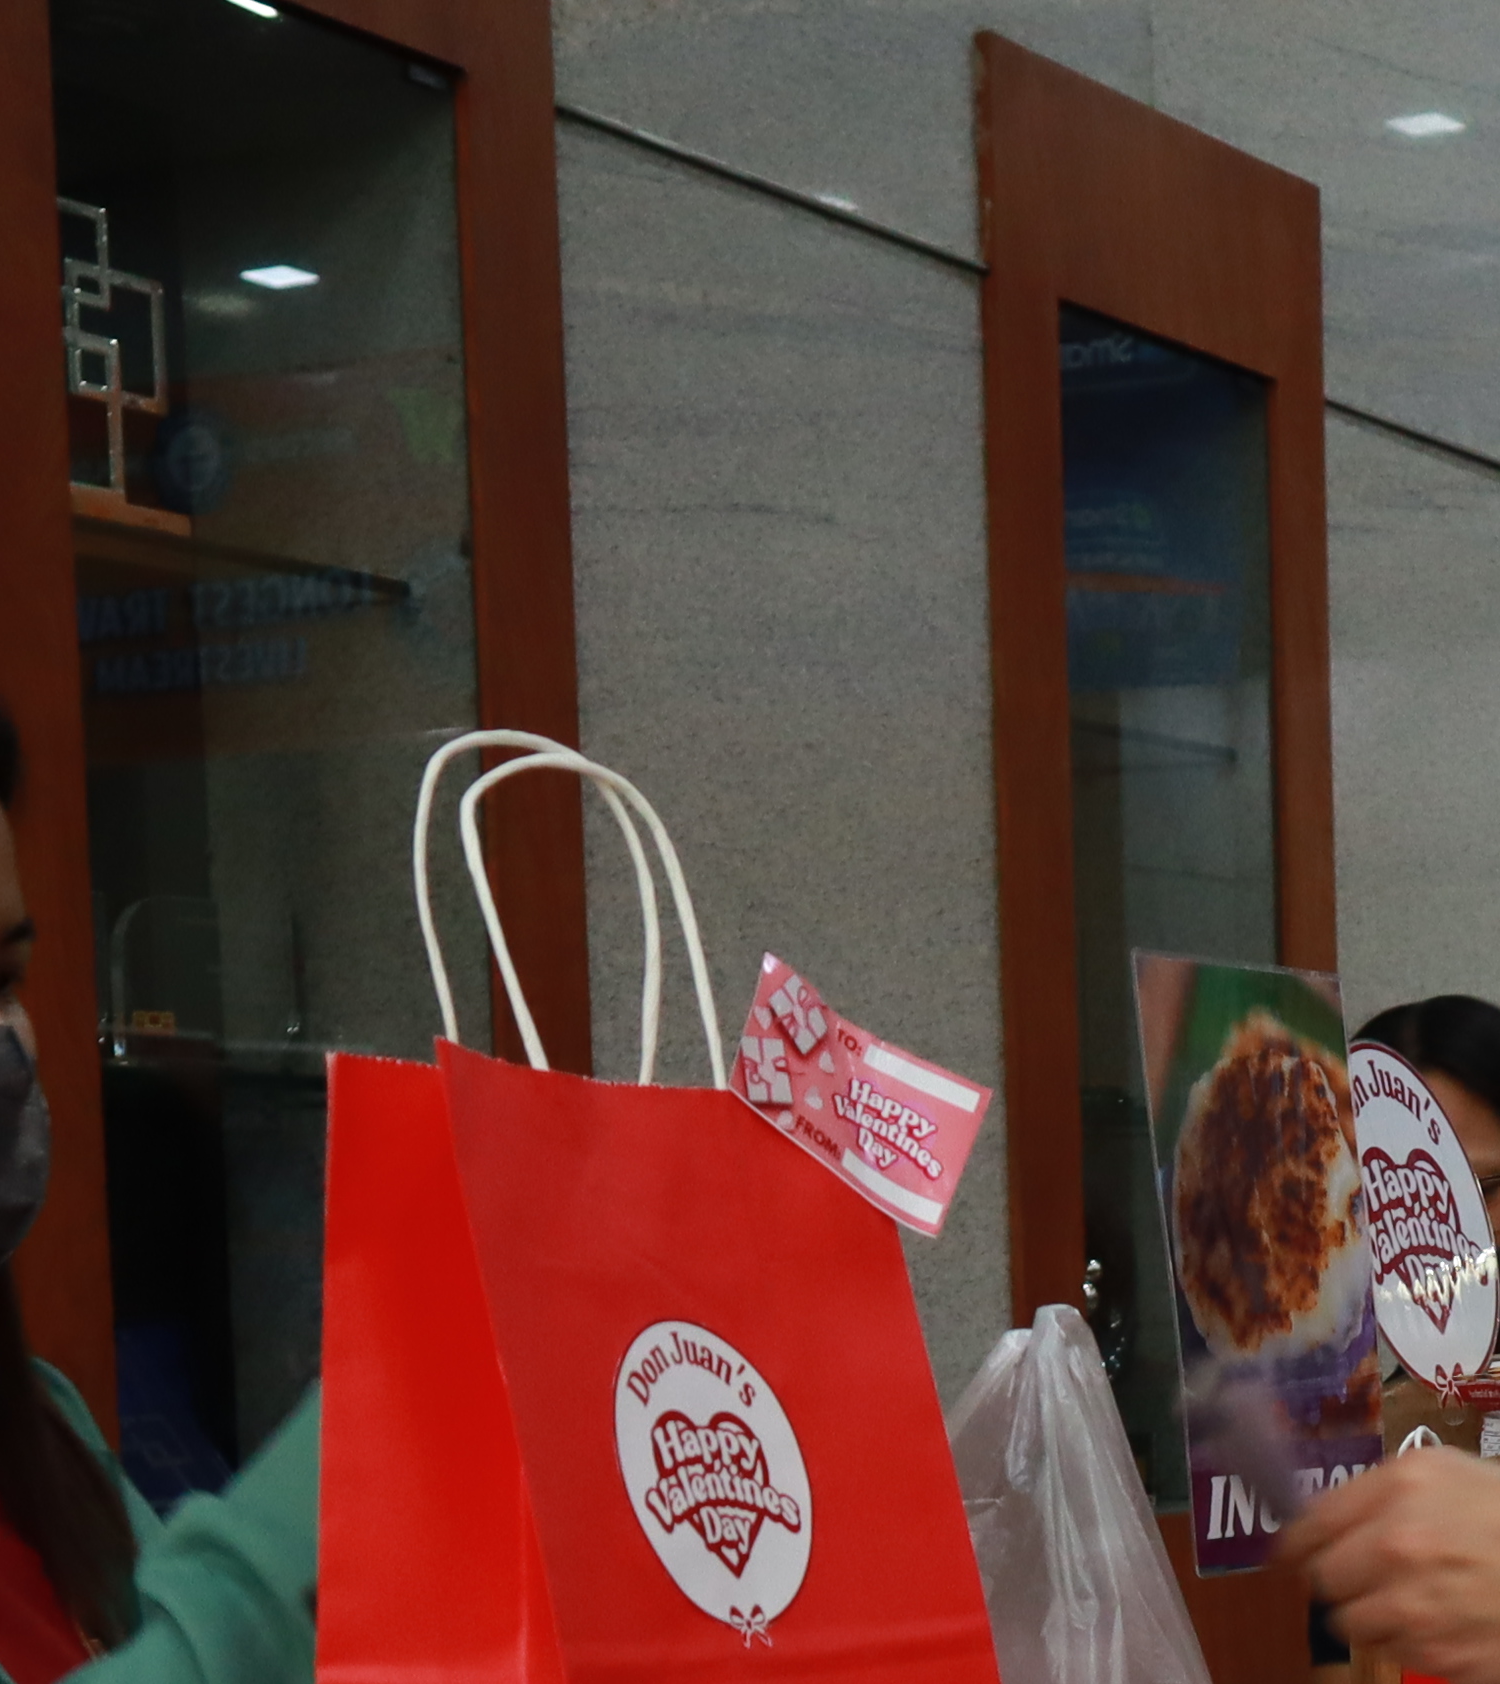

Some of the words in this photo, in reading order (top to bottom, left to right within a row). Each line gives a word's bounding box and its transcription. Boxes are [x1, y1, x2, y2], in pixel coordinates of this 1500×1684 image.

[837, 1028, 863, 1057] TO:
[851, 1077, 937, 1138] Happy
[1367, 1058, 1442, 1146] Juan's
[793, 1112, 842, 1161] FROM:
[833, 1092, 943, 1179] Valentines
[857, 1126, 899, 1170] Day
[1362, 1157, 1452, 1215] Happy
[626, 1345, 671, 1407] Don
[669, 1331, 757, 1408] Juan's
[653, 1419, 760, 1472] Happy
[646, 1463, 801, 1530] Valentines
[700, 1506, 752, 1556] Day
